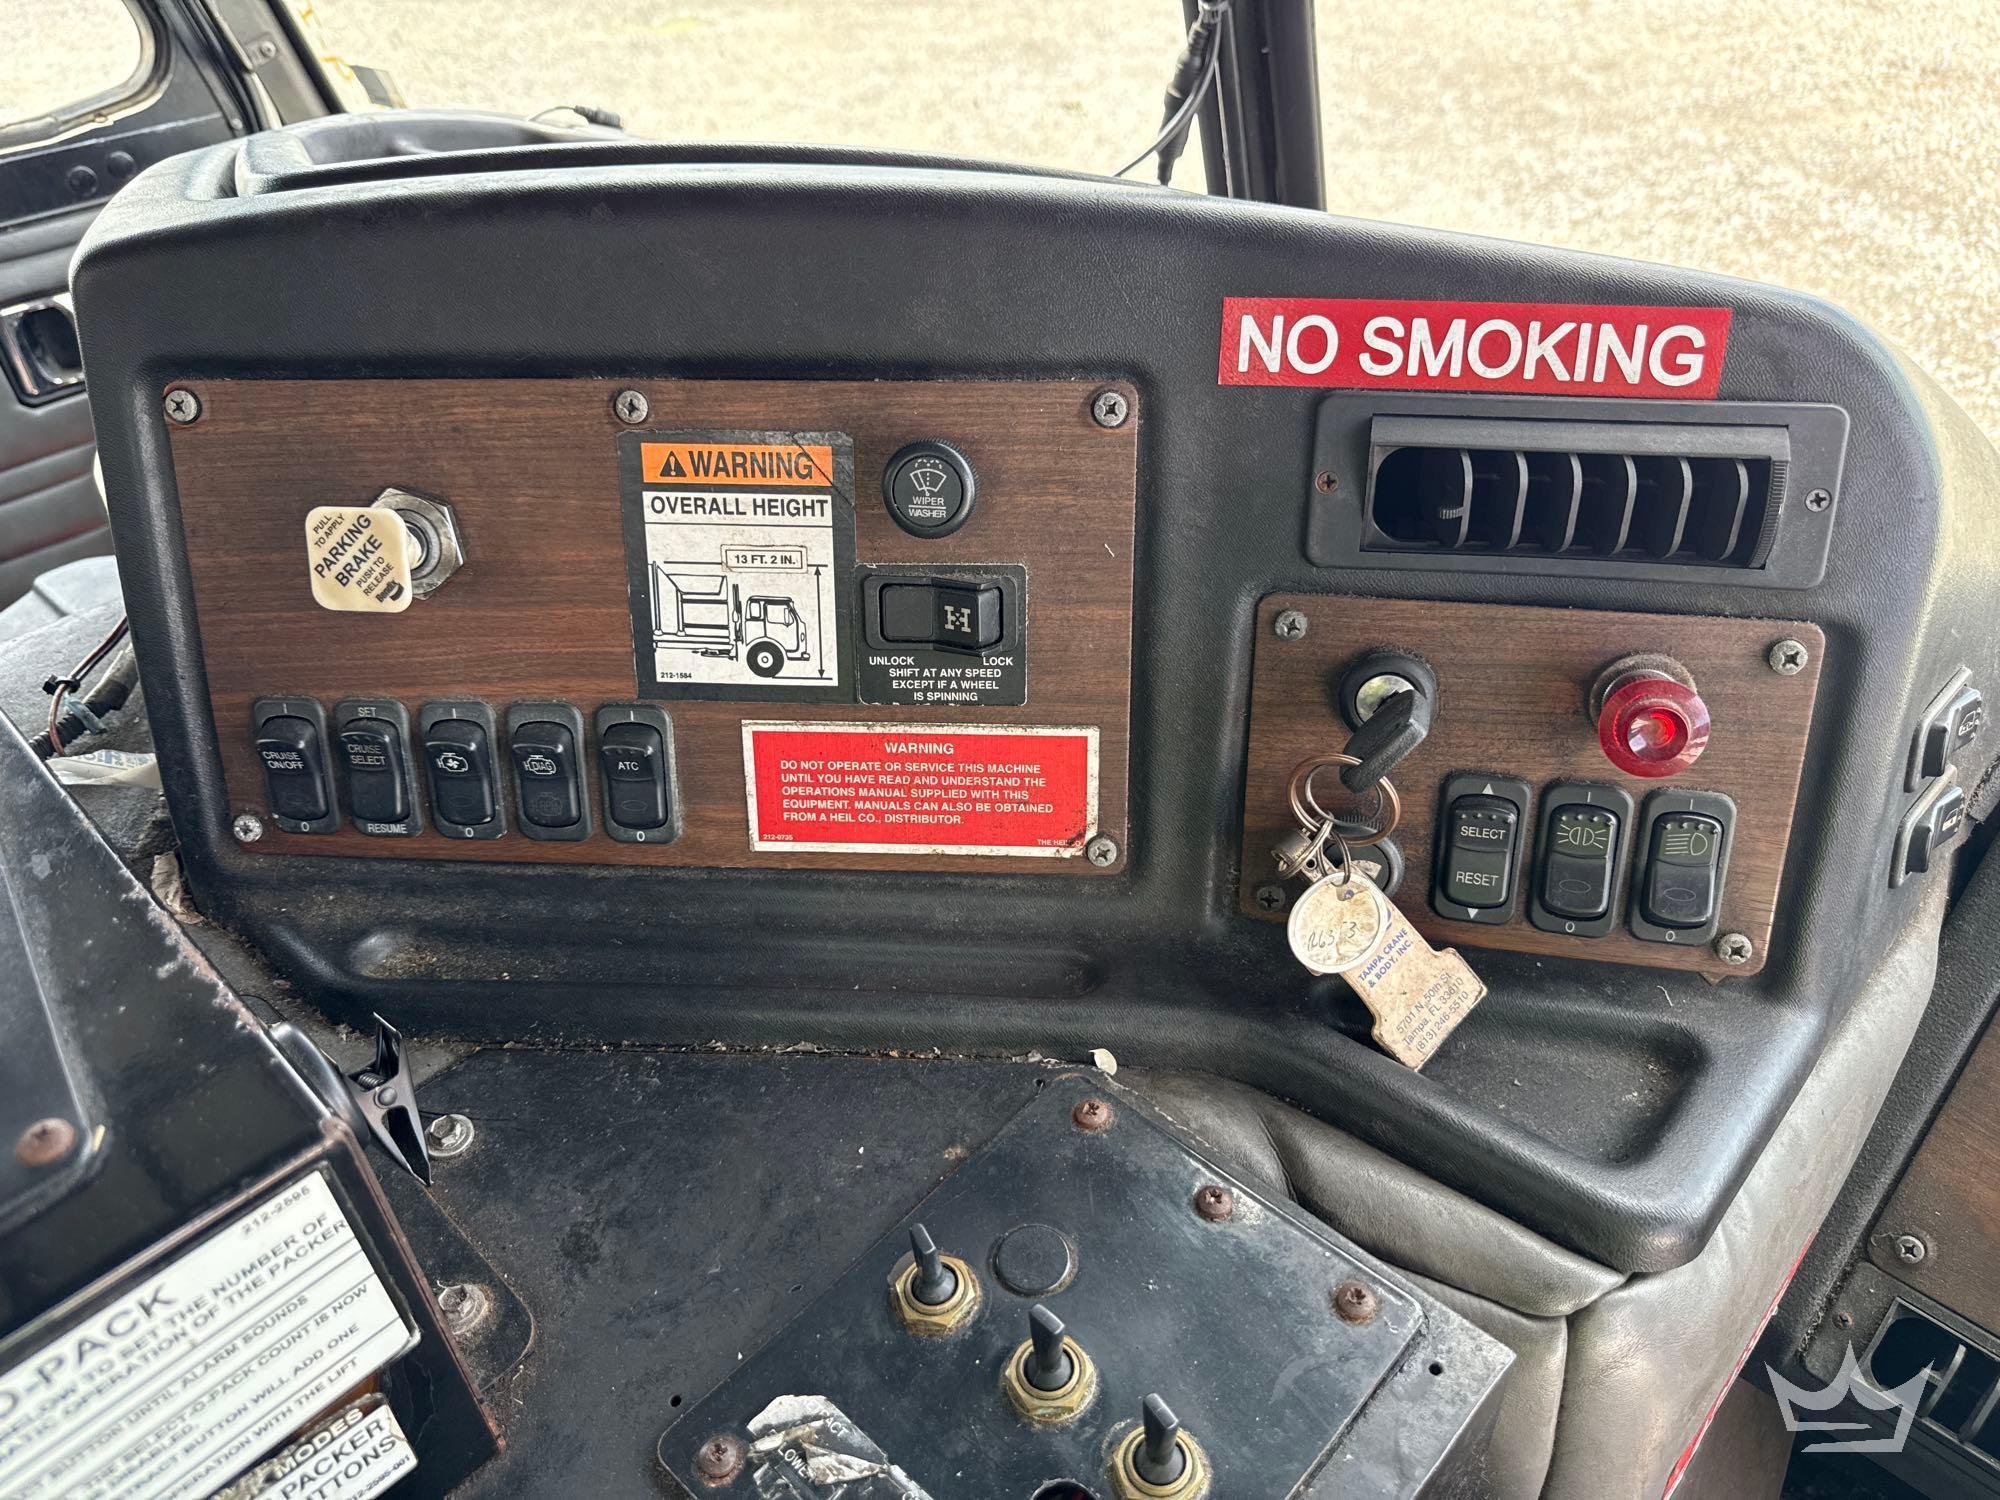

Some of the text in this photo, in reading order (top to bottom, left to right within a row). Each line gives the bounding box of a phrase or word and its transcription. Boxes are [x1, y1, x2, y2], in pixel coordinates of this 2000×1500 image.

[1237, 314, 1706, 387] NO SMOKING
[688, 450, 813, 480] WARNING
[651, 496, 828, 517] OVERALL HEIGHT
[912, 497, 944, 505] WIPER
[908, 509, 946, 518] WASHER
[312, 513, 331, 534] PULL
[314, 513, 346, 549] TO APPLY
[313, 512, 372, 578] PARKING
[334, 534, 382, 587] BRAKE
[734, 555, 796, 565] 13 FT. 2 IN.
[355, 555, 385, 588] PUSH TO
[363, 562, 394, 596] RELEASE
[869, 656, 1013, 666] UNLOCK LOCK
[889, 668, 1002, 678] SHIFT AT ANY SPEED
[892, 680, 999, 690] EXCEPT IF A WHEEL
[914, 692, 978, 701] IS SPINNING
[357, 707, 377, 717] SET
[262, 751, 301, 761] CRUISE
[347, 744, 382, 754] CRUISE
[885, 742, 954, 755] WARNING
[267, 760, 304, 770] ON/OFF
[352, 756, 386, 766] SELECT
[618, 761, 640, 771] ATC
[780, 760, 1041, 774] DO NOT OPERATE OR SERVICE THIS MACHINE
[781, 773, 1046, 787] UNTIL YOU HAVE READ AND UNDERSTAND THE
[782, 786, 1030, 800] OPERATIONS MANUAL SUPPLIED WITH THIS
[854, 800, 911, 811] MANUALS
[913, 801, 939, 811] CAN
[941, 802, 973, 812] ALSO
[975, 803, 991, 812] BE
[994, 803, 1054, 814] OBTAINED
[783, 812, 817, 822] FROM
[819, 813, 826, 822] A
[829, 813, 856, 823] HEIL
[884, 814, 965, 825] DISTRIBUTOR.
[368, 823, 408, 834] RESUME
[1460, 825, 1506, 840] SELECT
[1037, 838, 1052, 846] THE
[1456, 871, 1499, 887] RESET
[1357, 927, 1407, 981] TAMPA CRANE
[1373, 954, 1398, 980] BODY,
[1395, 937, 1413, 956] INC.
[1427, 1001, 1441, 1016] FL
[1438, 976, 1464, 1004] 33610
[1395, 1011, 1416, 1034] 5701
[1422, 981, 1442, 1002] 50th
[1414, 990, 1469, 1053] (813) 246-5510
[191, 1302, 223, 1329] OF
[224, 1273, 266, 1306] THE
[267, 1218, 347, 1277] PACKER
[83, 1357, 115, 1384] TO
[120, 1327, 160, 1359] SET
[166, 1293, 209, 1328] THE
[210, 1233, 298, 1298] NUMBER
[300, 1212, 330, 1237] OF
[256, 1323, 312, 1367] COUNT
[330, 1283, 369, 1314] NOW
[128, 1387, 177, 1424] UNTIL
[179, 1342, 240, 1388] ALARM
[241, 1294, 309, 1344] SOUNDS
[182, 1403, 249, 1455] BUTTON
[250, 1373, 290, 1406] WILL
[291, 1348, 324, 1376] ADD
[326, 1322, 359, 1349] ONE
[253, 1405, 293, 1438] WITH
[293, 1381, 325, 1408] THE
[326, 1356, 359, 1383] LIFT
[274, 1408, 363, 1479] MODES
[281, 1418, 384, 1500] PACKER
[777, 1442, 817, 1482] LOWE
